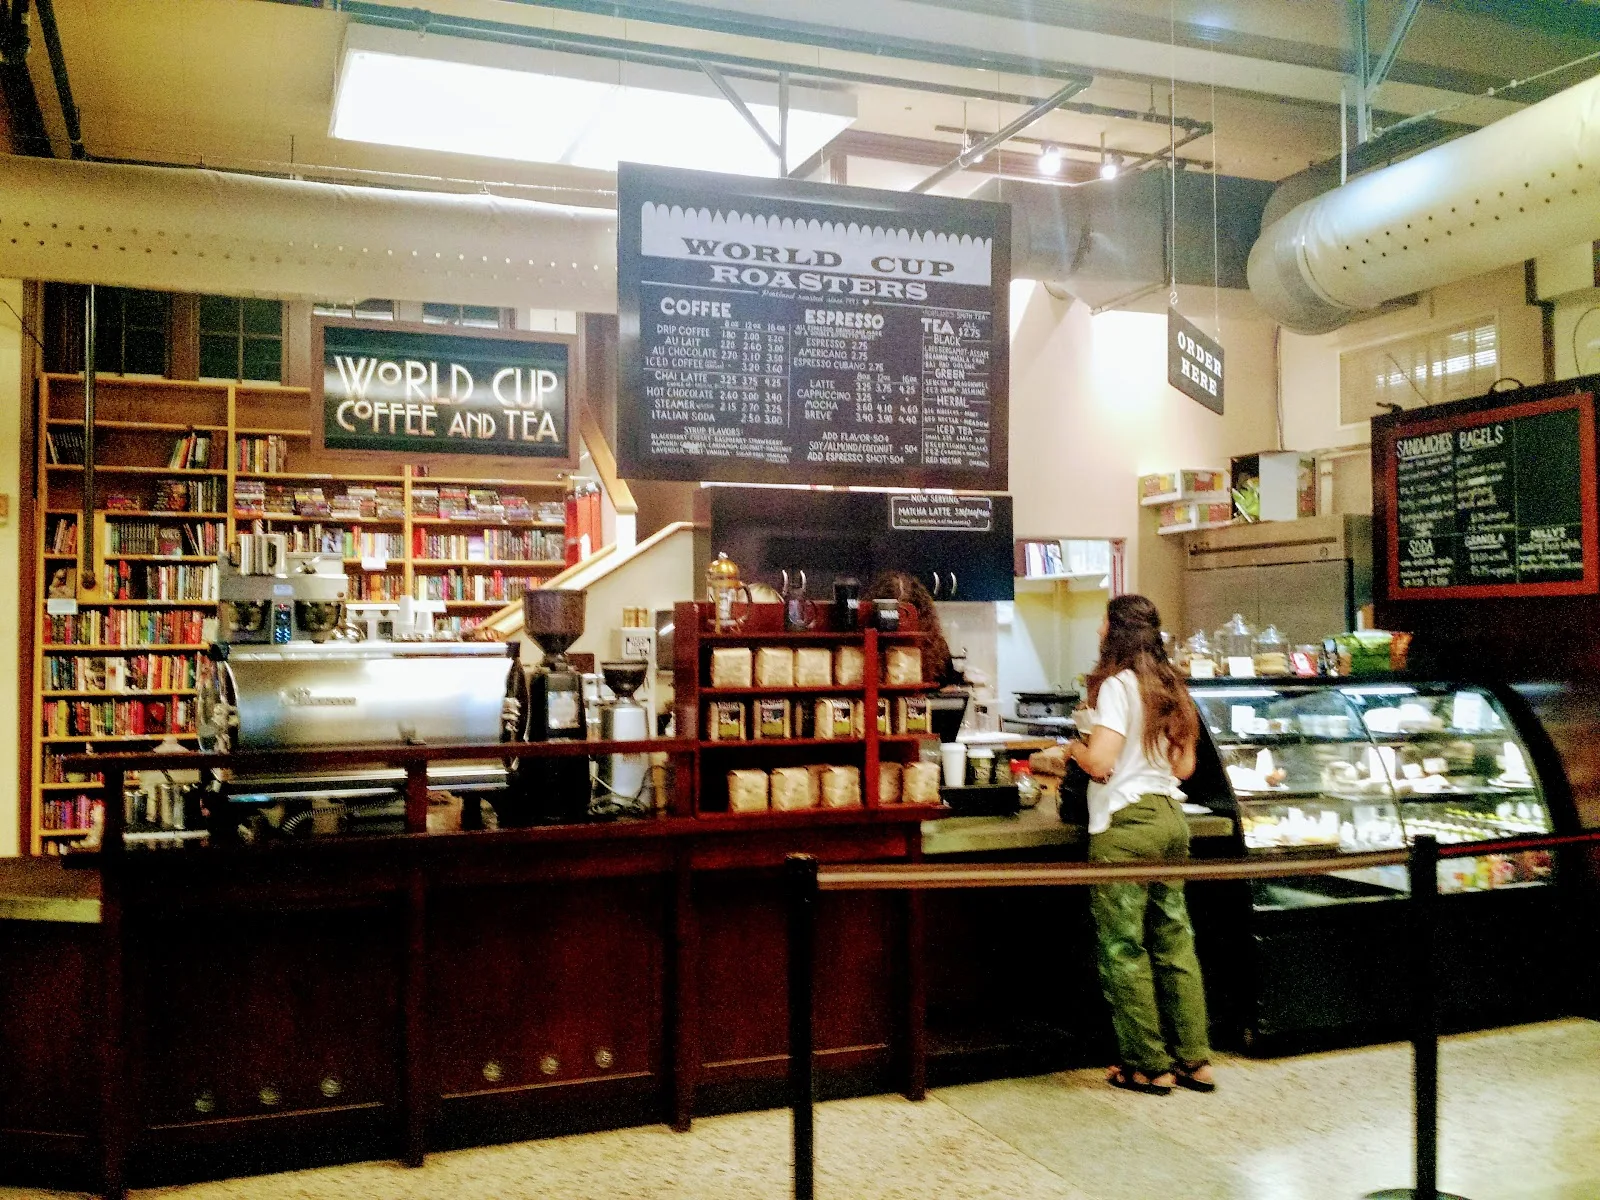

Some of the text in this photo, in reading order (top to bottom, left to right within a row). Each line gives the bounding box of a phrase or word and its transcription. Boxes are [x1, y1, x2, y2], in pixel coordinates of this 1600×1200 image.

[681, 237, 954, 277] WORLD CUP
[710, 265, 928, 300] ROASTERS
[660, 297, 731, 319] COFFEE
[805, 309, 884, 330] ESPRESSO
[656, 324, 676, 334] DRIP
[679, 326, 710, 337] COFFEE
[744, 332, 760, 340] 2.00
[921, 318, 954, 334] TEA
[665, 336, 678, 345] AU
[681, 338, 700, 346] LAIT
[744, 342, 761, 351] 2.60
[807, 338, 845, 349] ESPRESSO
[934, 334, 960, 346] BLACK
[652, 346, 664, 355] AU
[668, 347, 717, 359] CHOCOLATE
[743, 352, 760, 361] 3.10
[799, 348, 868, 360] AMERICANO 2.75
[1178, 331, 1221, 378] ORDER
[646, 356, 668, 366] ICED
[672, 358, 702, 368] COFFEE
[742, 363, 760, 371] 3.20
[766, 365, 782, 373] 3.60
[794, 358, 831, 368] ESPRESSO
[833, 360, 866, 370] CUBANO
[655, 371, 676, 380] CHAI
[680, 372, 707, 382] LATTE
[935, 369, 965, 379] GREEN
[1181, 357, 1217, 396] HERE
[334, 355, 558, 409] WORLD CUP
[810, 380, 835, 389] LATTE
[646, 387, 665, 396] HOT
[666, 388, 713, 399] CHOCOLATE
[720, 391, 738, 400] 2.60
[742, 392, 759, 400] 3.00
[797, 389, 850, 401] CAPPUCCINO
[655, 399, 695, 409] STEAMER
[805, 401, 838, 410] MOCHA
[937, 395, 969, 408] HERBAL
[337, 400, 559, 443] COFFEE AND TEA
[651, 410, 782, 424] ITALIAN SODA 2.50 3.00
[805, 411, 832, 420] BREVE
[684, 426, 706, 434] SYRUP
[822, 432, 838, 440] ADD
[937, 425, 973, 436] ICED TEA
[1459, 425, 1503, 450] BAGELS
[807, 452, 823, 461] ADD
[826, 453, 863, 462] ESPRESSO
[926, 456, 938, 464] RED
[930, 496, 959, 504] SERVING
[899, 507, 926, 516] MATCHA
[929, 507, 951, 516] LATTE
